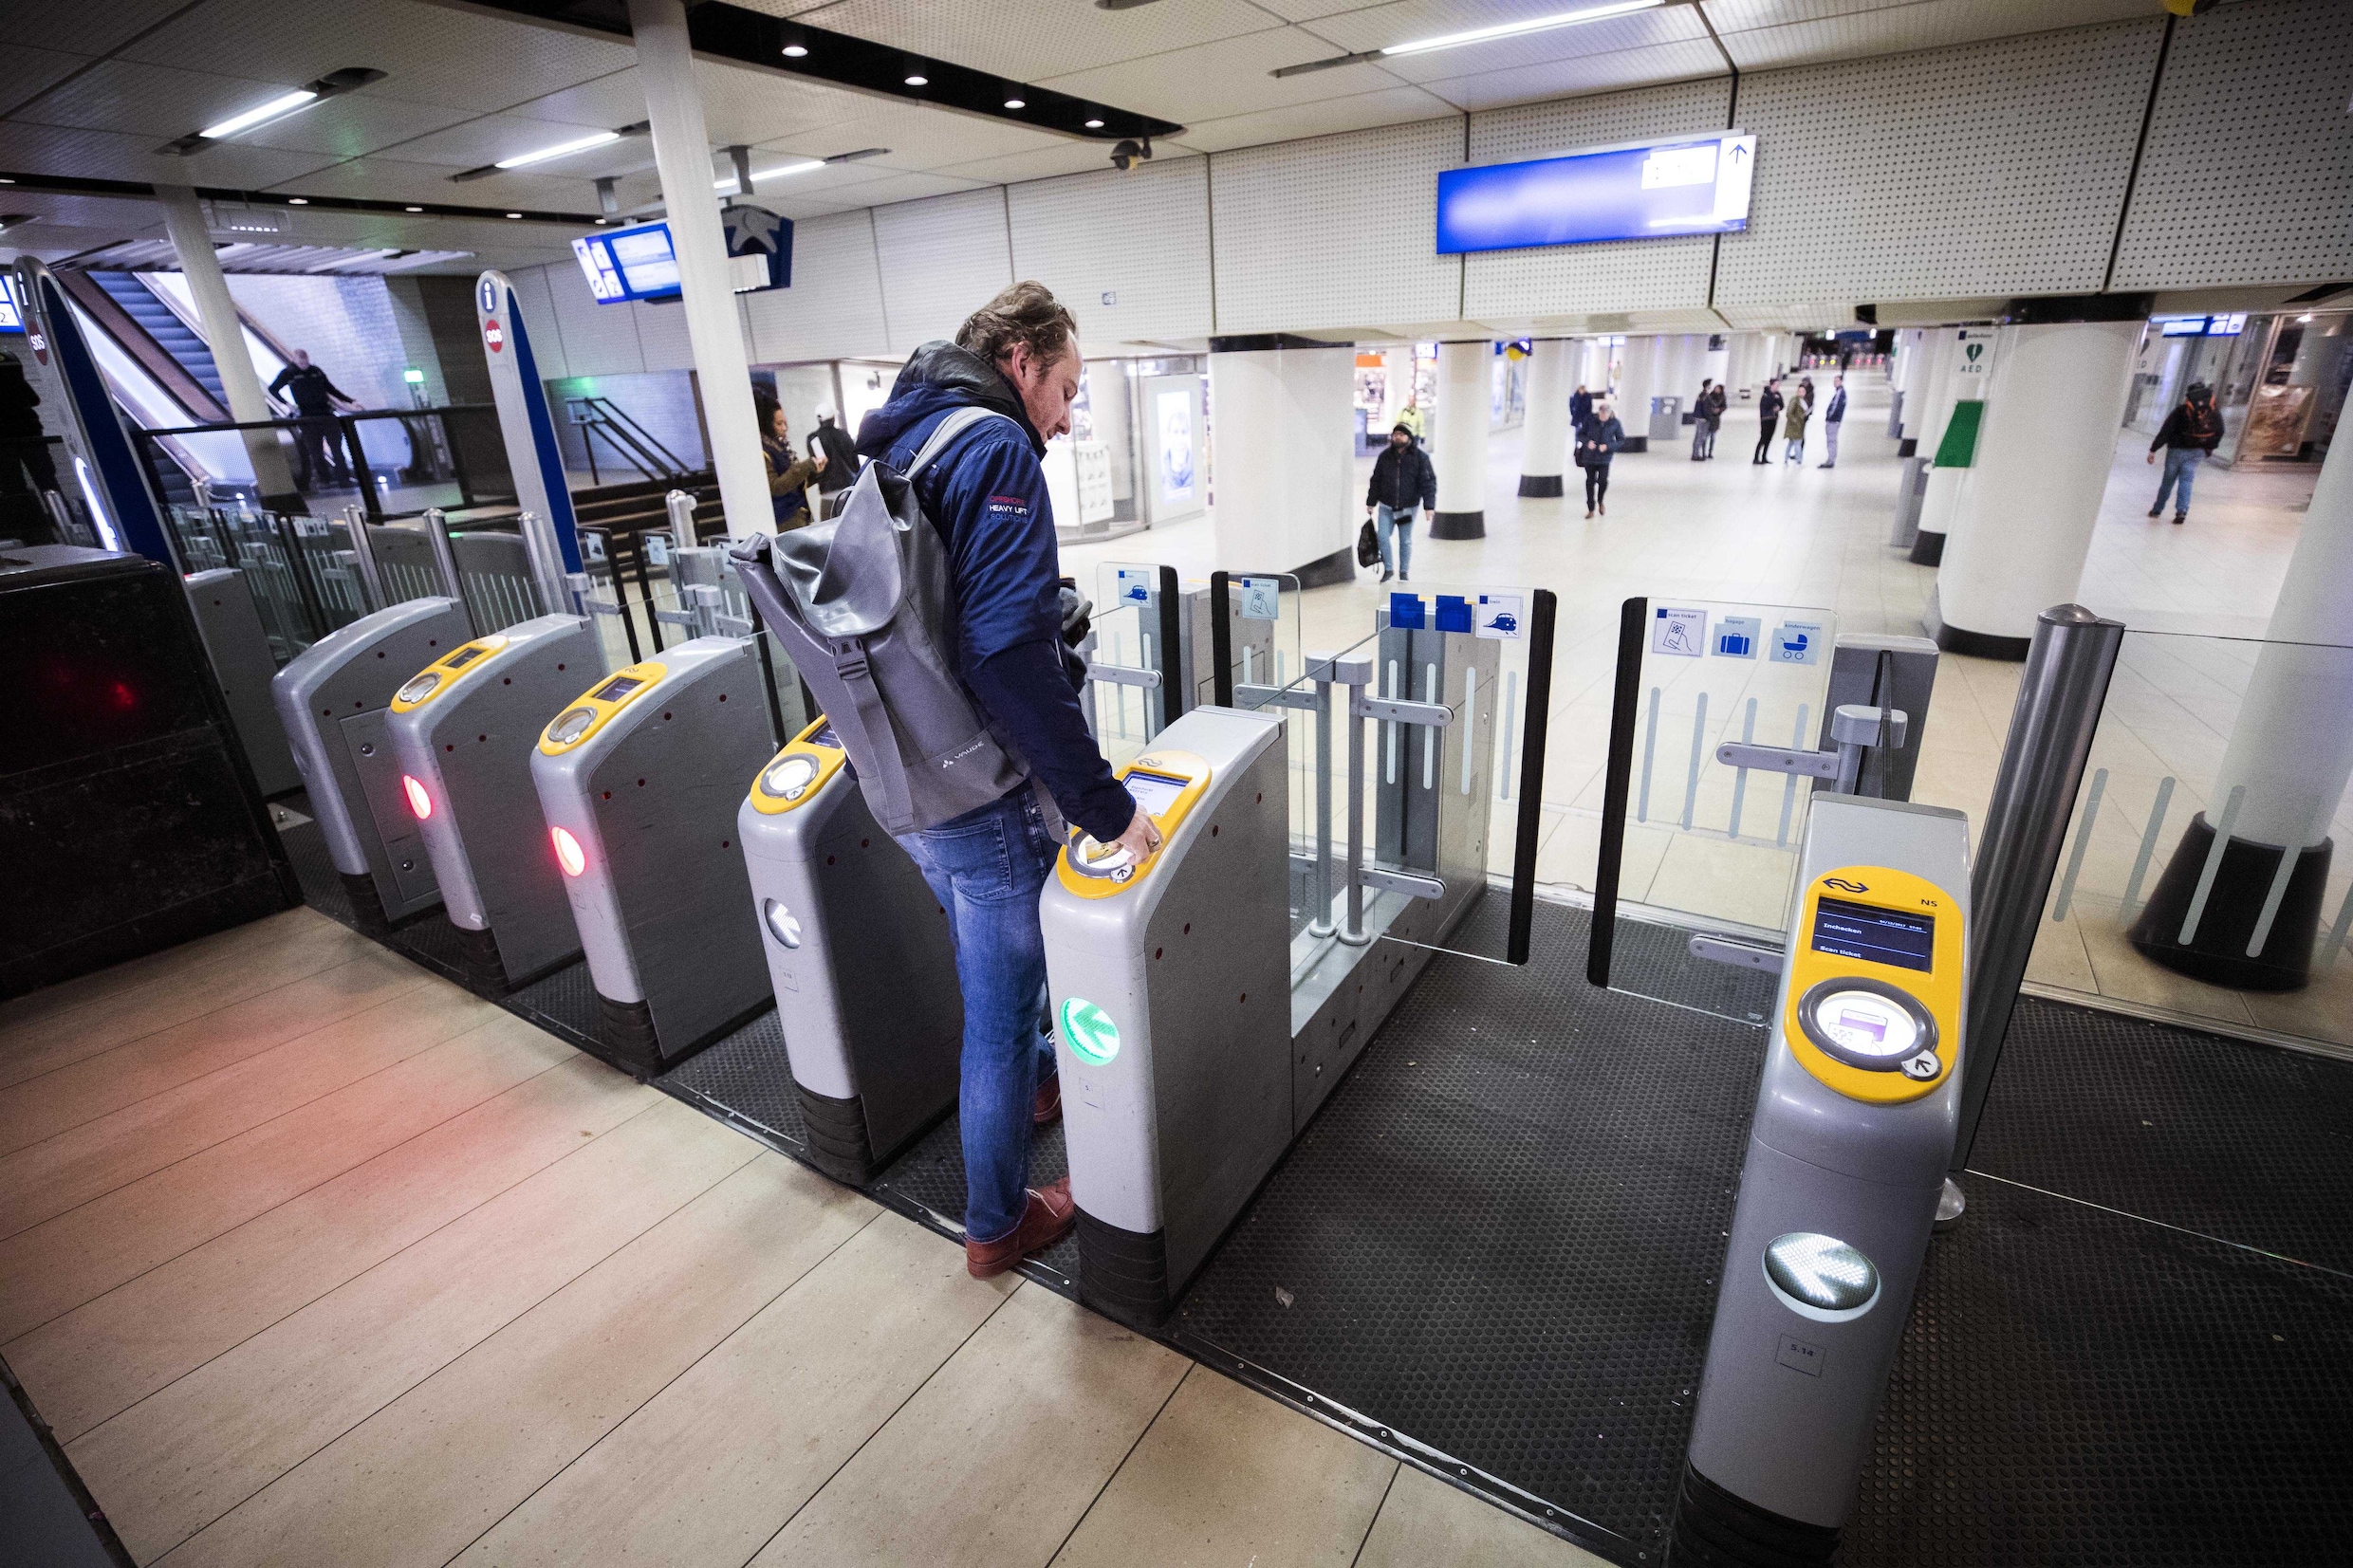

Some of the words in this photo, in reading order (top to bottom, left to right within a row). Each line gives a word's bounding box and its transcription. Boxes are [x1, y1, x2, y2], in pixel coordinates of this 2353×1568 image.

[29, 333, 46, 351] SOS
[486, 328, 503, 343] SOS
[1960, 364, 1983, 374] AED
[989, 505, 1013, 513] HEAVY
[1014, 507, 1028, 515] LIFT
[1785, 622, 1821, 631] kinderwagen
[954, 740, 985, 759] VAUDE
[1920, 898, 1938, 908] NS
[1823, 922, 1862, 935] Inchecken
[1819, 945, 1839, 954] Scan
[1839, 950, 1862, 959] ticket
[1790, 1343, 1814, 1357] 5.14
